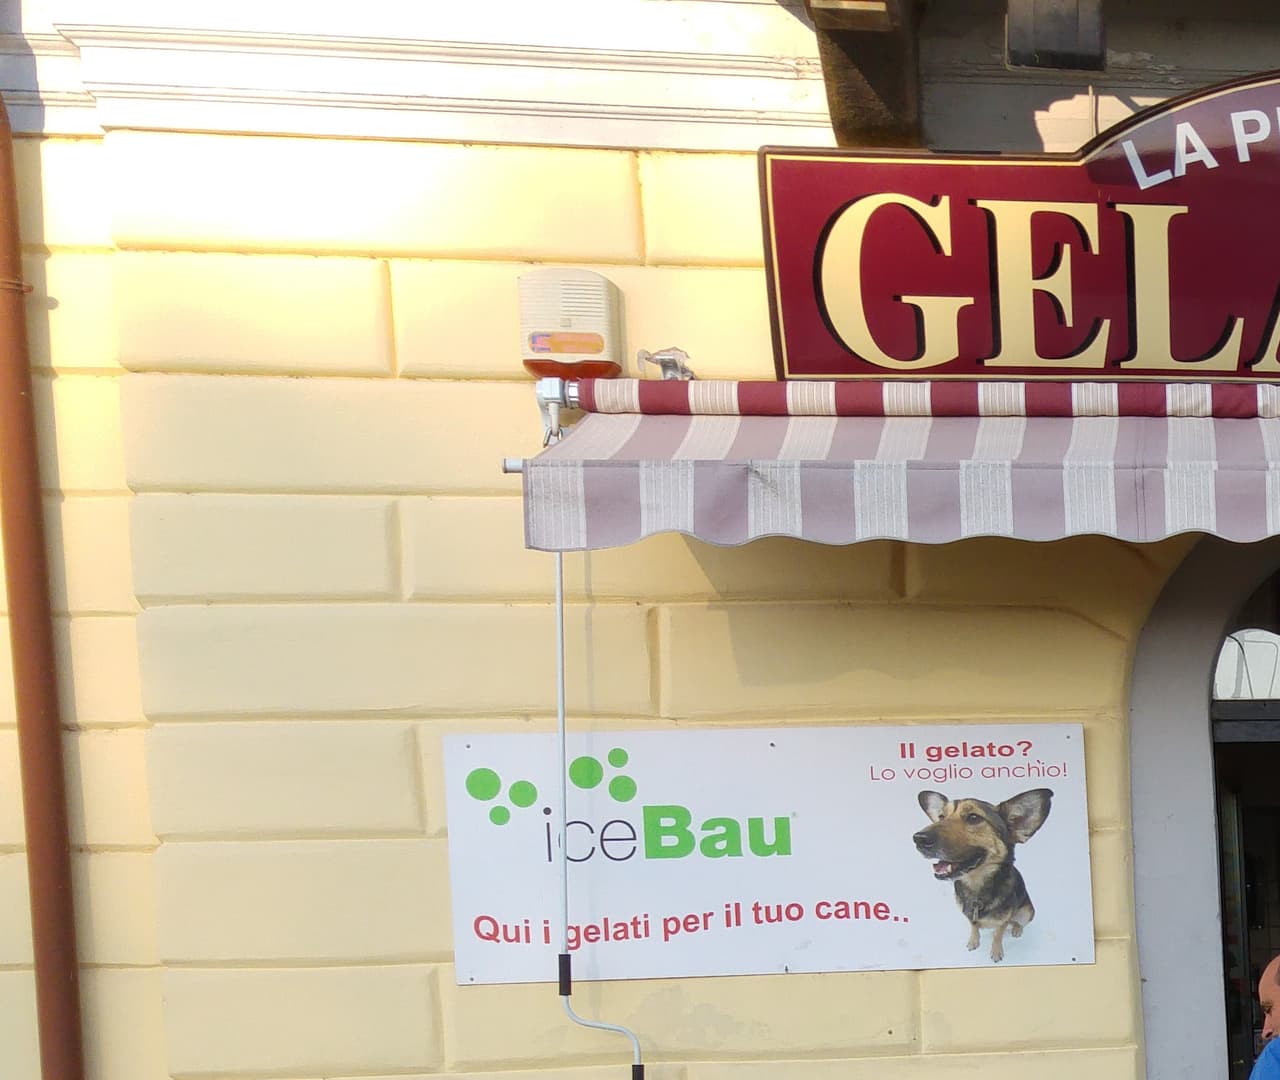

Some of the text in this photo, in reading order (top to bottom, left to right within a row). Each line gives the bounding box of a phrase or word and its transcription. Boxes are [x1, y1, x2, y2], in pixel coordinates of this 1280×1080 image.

[1123, 124, 1219, 190] LA
[870, 766, 896, 781] Lo
[904, 764, 973, 783] voglio
[900, 741, 1033, 762] Il gelato?
[543, 805, 792, 863] iceBau
[473, 901, 910, 951] Qui i gelati per il tuo cane..
